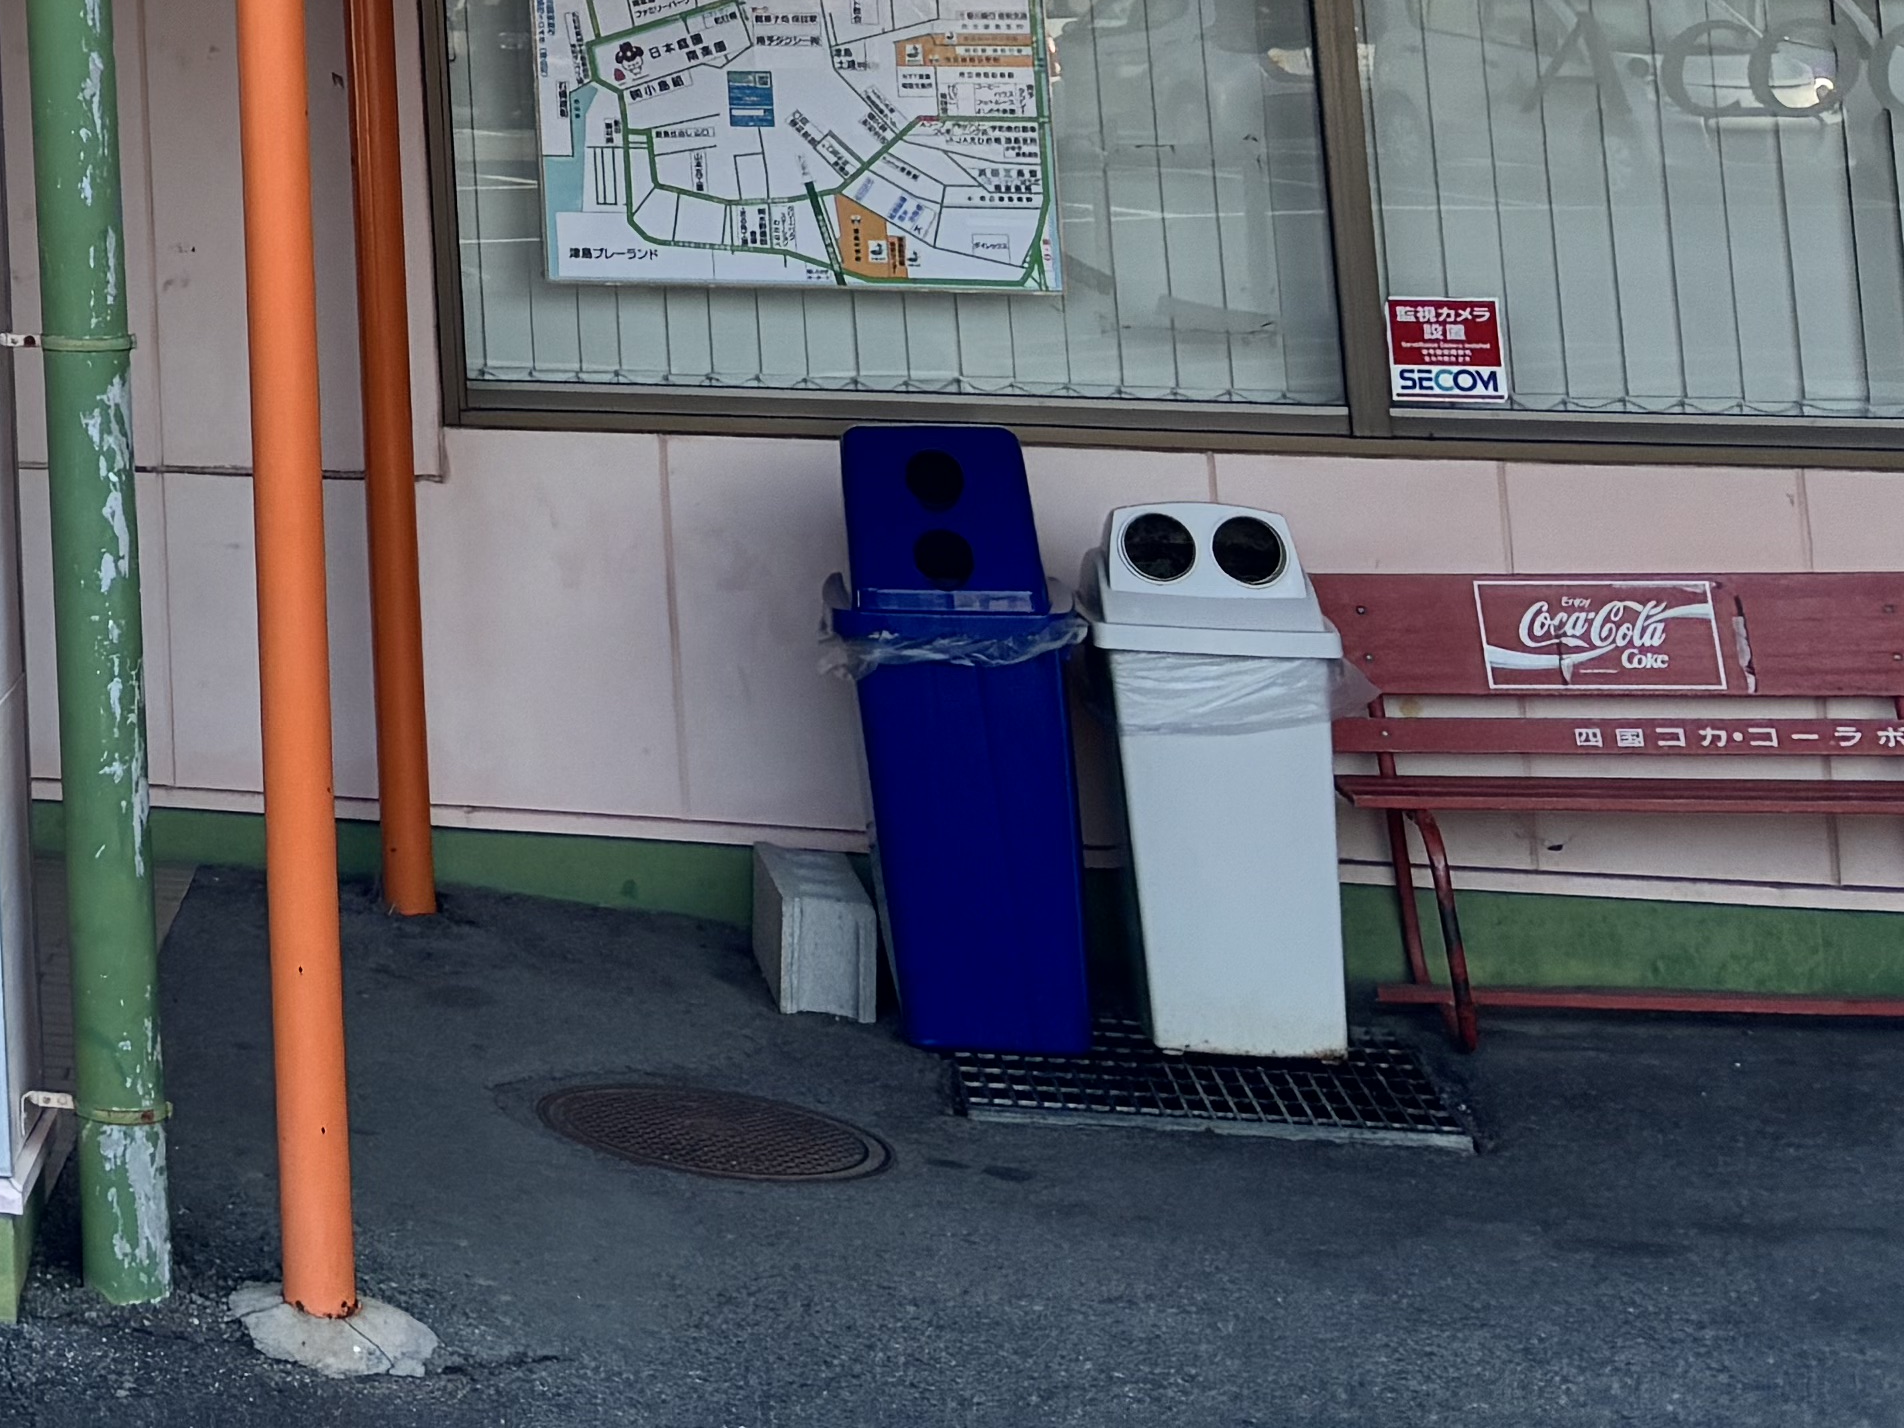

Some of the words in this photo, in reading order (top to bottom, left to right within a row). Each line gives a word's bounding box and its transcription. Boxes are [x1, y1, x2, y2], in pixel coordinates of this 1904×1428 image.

[1395, 306, 1491, 322] 監視カメラ
[1399, 368, 1499, 393] SECOM
[1518, 600, 1668, 648] Coca-Cola
[1620, 648, 1670, 670] Coke
